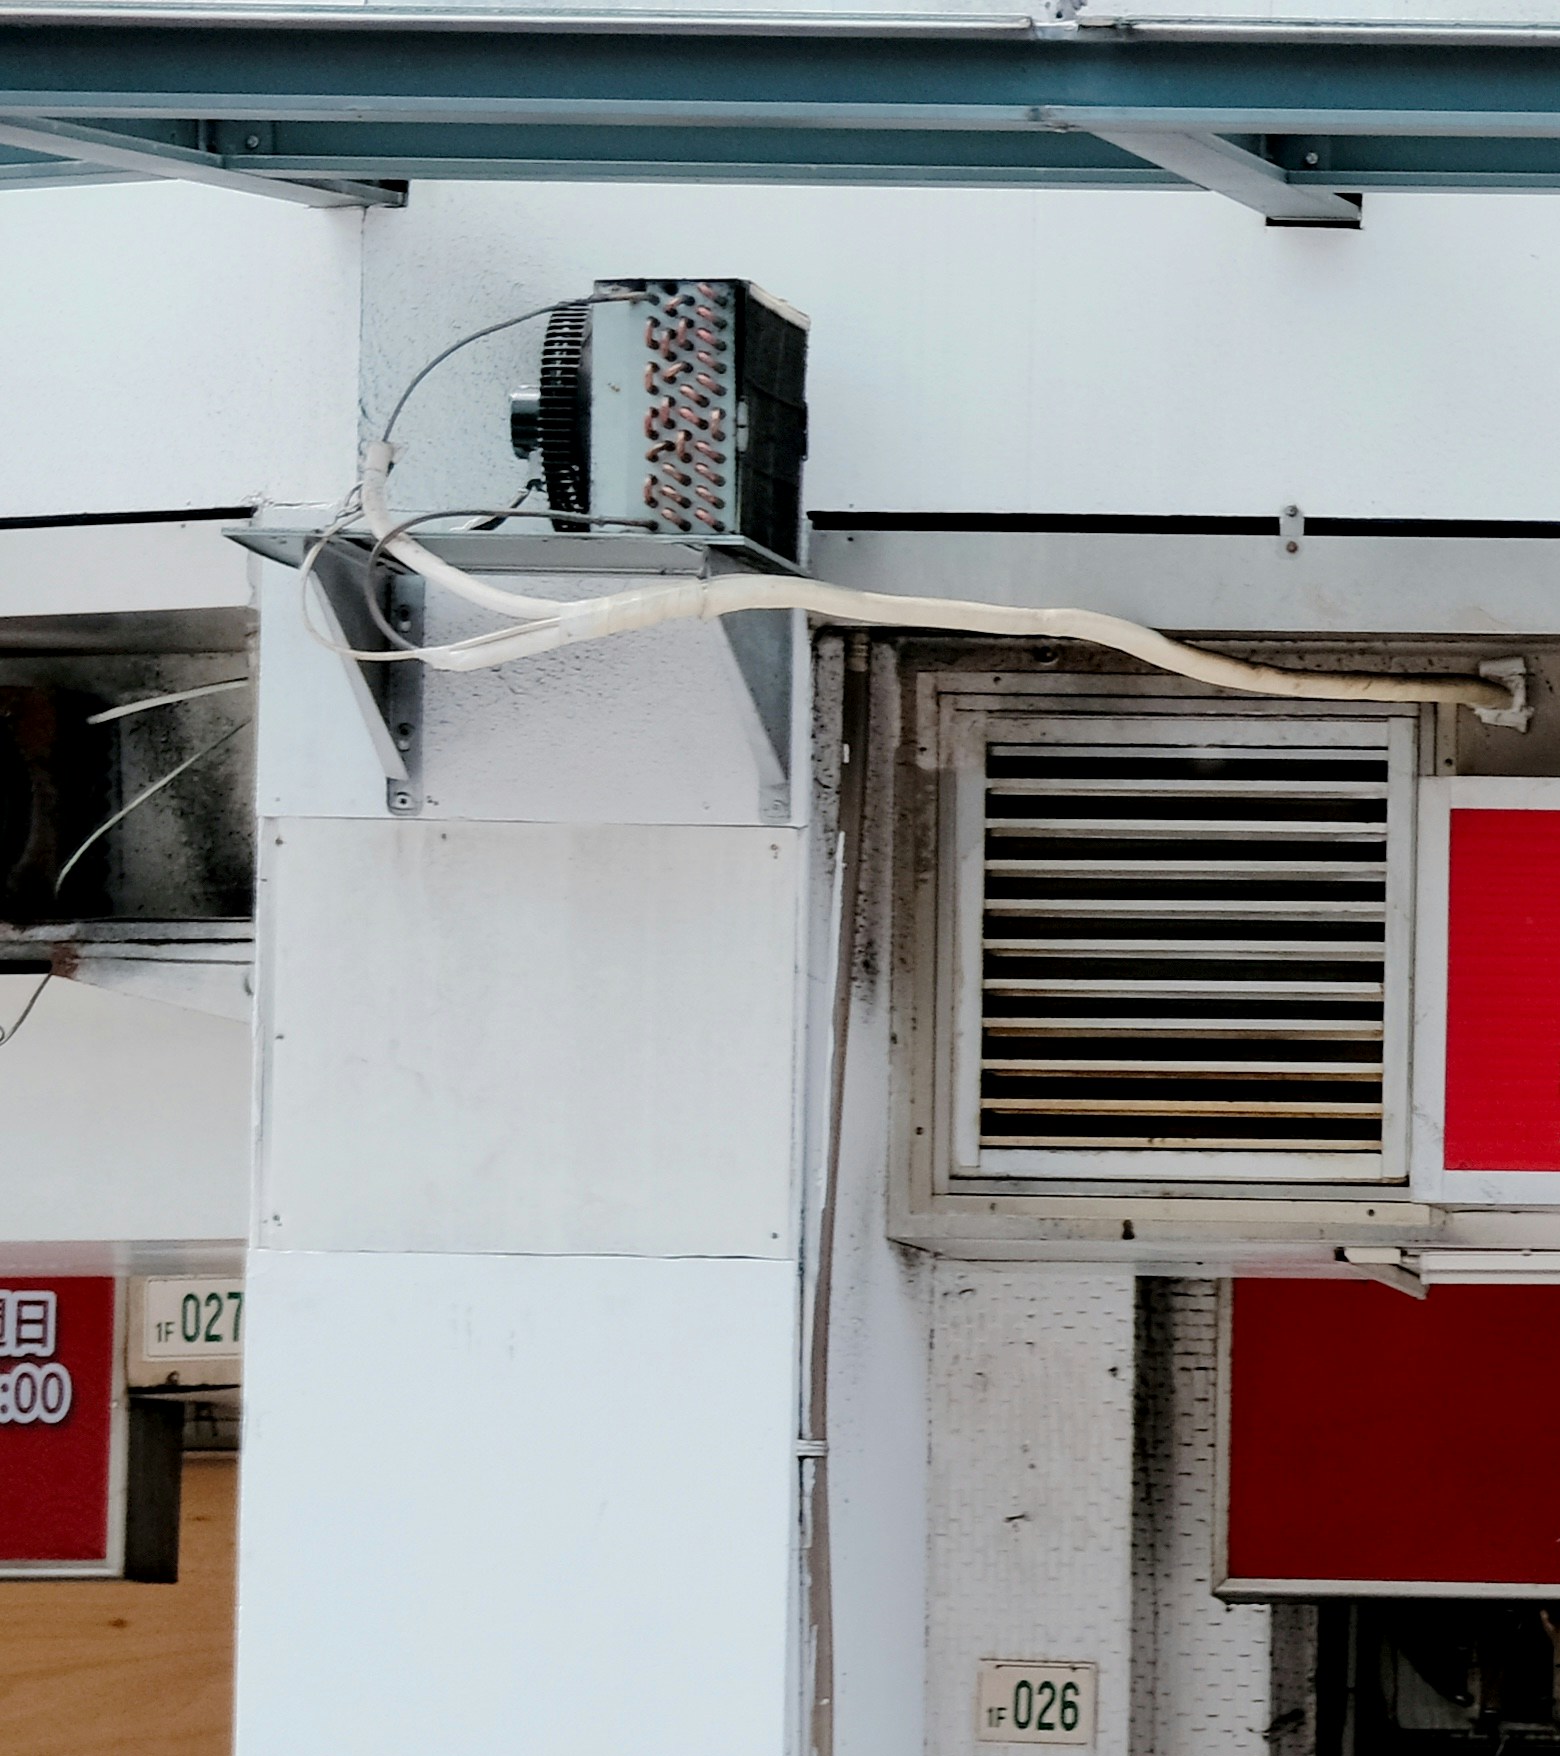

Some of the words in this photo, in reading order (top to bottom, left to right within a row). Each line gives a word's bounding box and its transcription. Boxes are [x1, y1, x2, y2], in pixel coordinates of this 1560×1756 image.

[156, 1322, 175, 1342] 1F
[181, 1292, 244, 1342] 027
[987, 1707, 1006, 1728] 1F
[1013, 1680, 1080, 1732] 026
